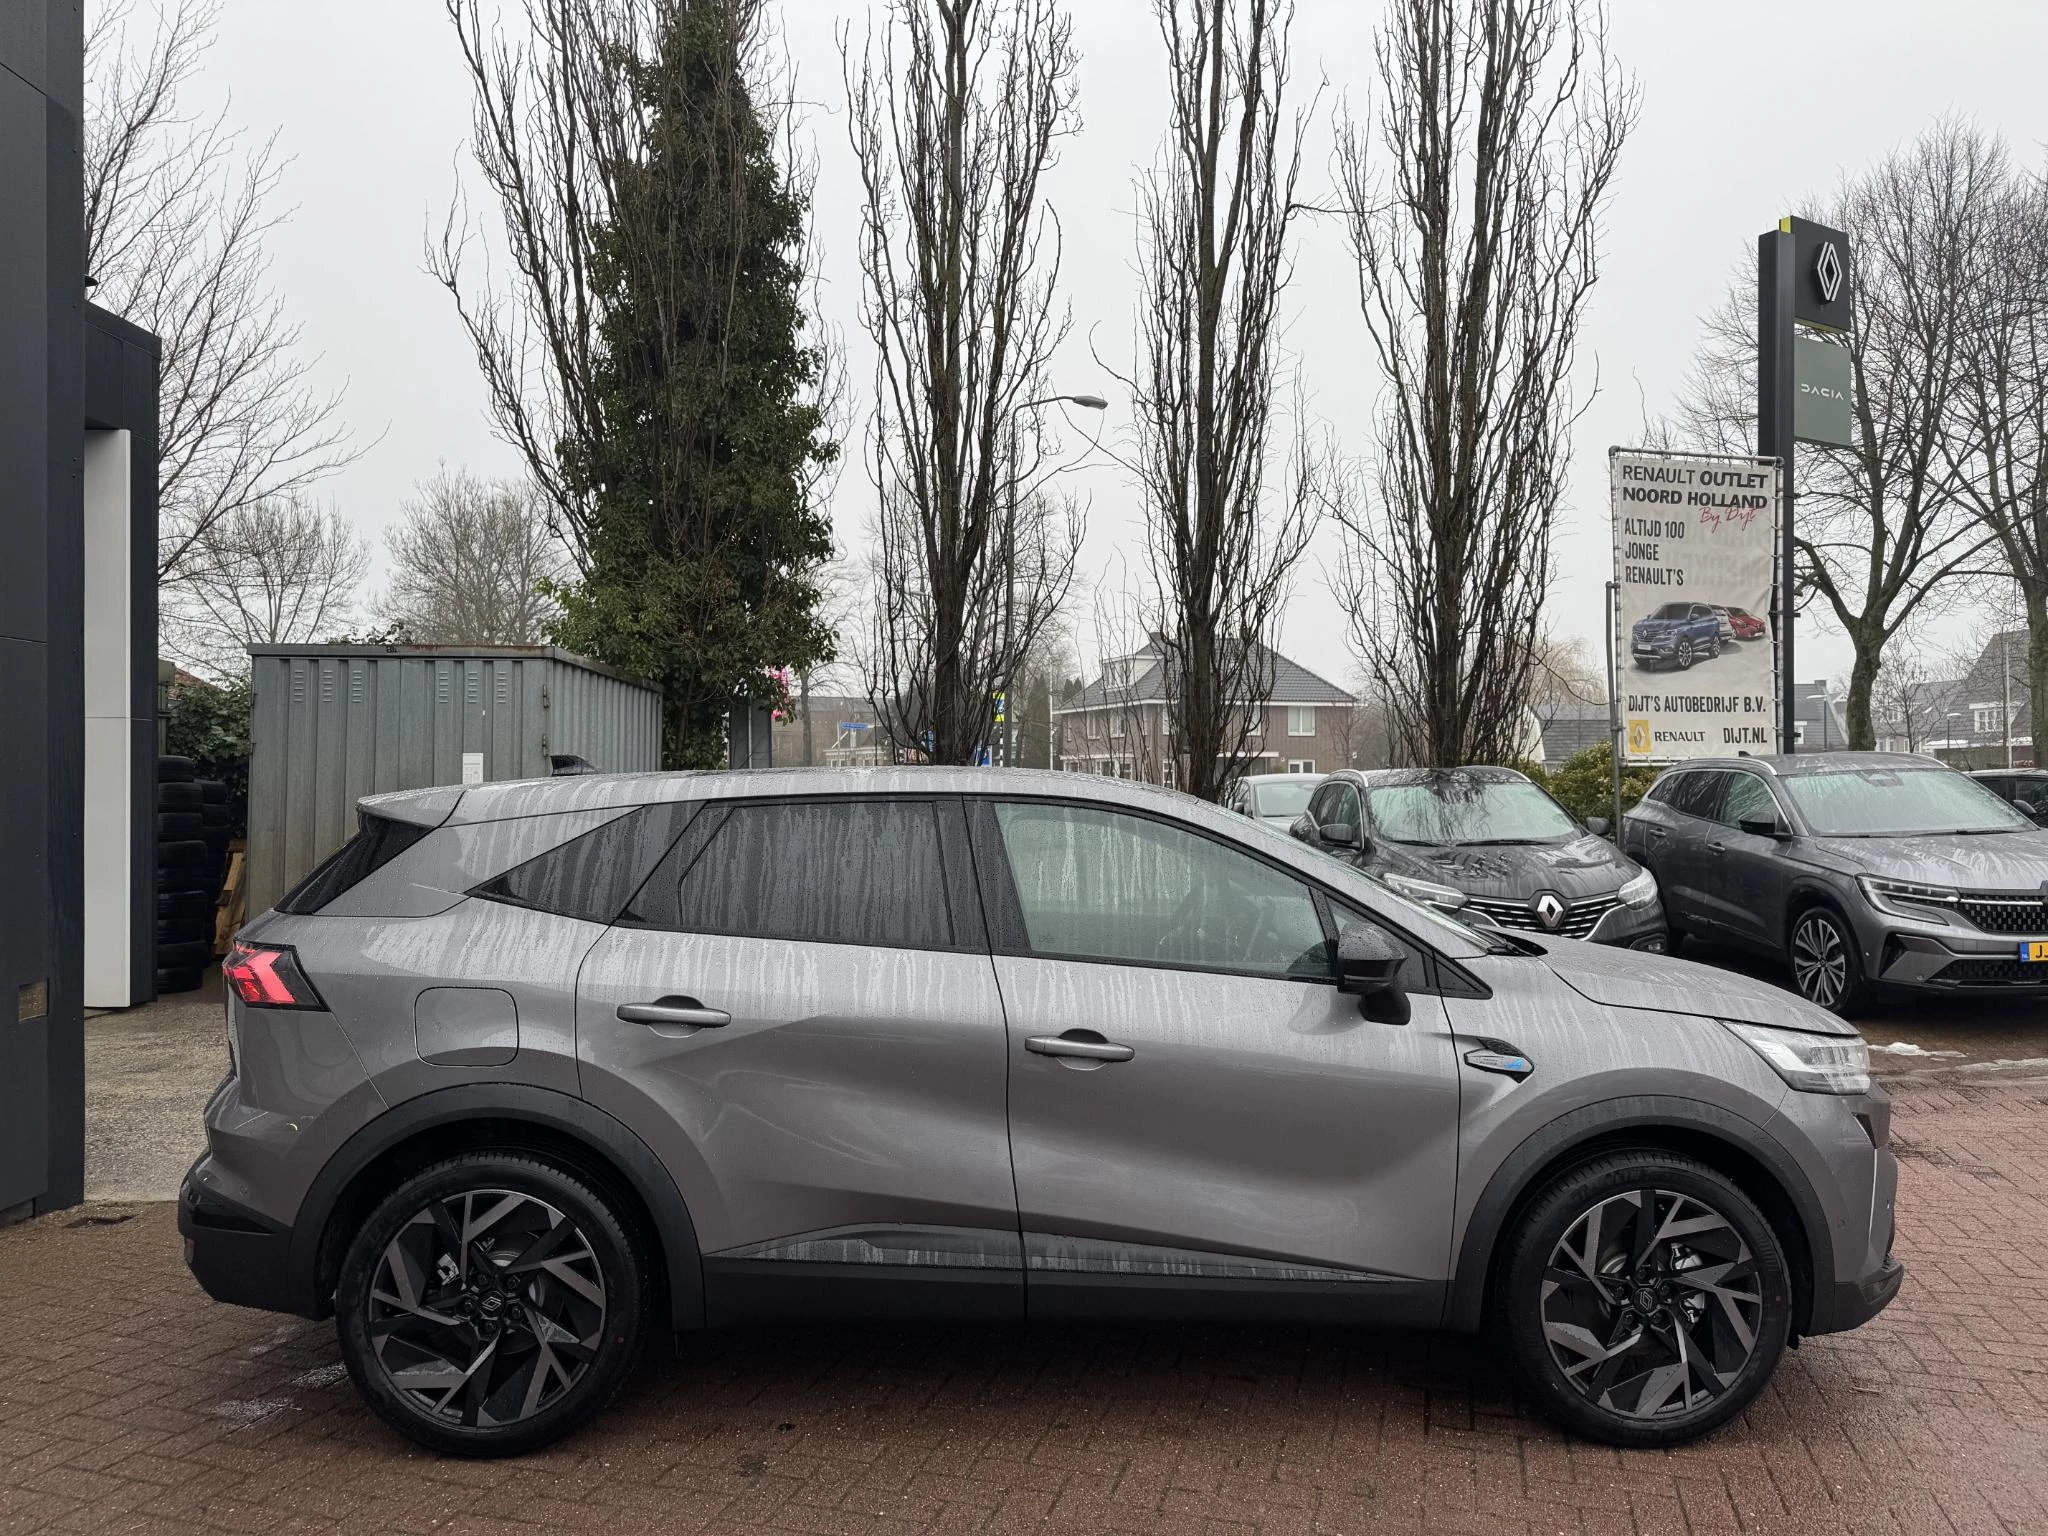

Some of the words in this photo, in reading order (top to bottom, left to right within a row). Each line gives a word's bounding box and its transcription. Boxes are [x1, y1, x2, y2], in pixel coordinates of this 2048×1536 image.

[1800, 383, 1844, 400] DACIA
[1622, 465, 1696, 484] RENAULT
[1699, 470, 1769, 489] OUTLET
[1622, 486, 1683, 505] NOORD
[1687, 491, 1768, 509] HOLLAND
[1624, 518, 1662, 537] ALTIJD
[1664, 521, 1685, 539] 100
[1625, 541, 1659, 561] JONGE
[1625, 565, 1684, 586] RENAULT'S
[1628, 694, 1661, 713] DIJT'S
[1664, 696, 1740, 713] AUTOBEDRIJF
[1743, 696, 1766, 713] B.V.
[1654, 731, 1706, 742] RENAULT
[1723, 727, 1767, 744] DIJT.NL
